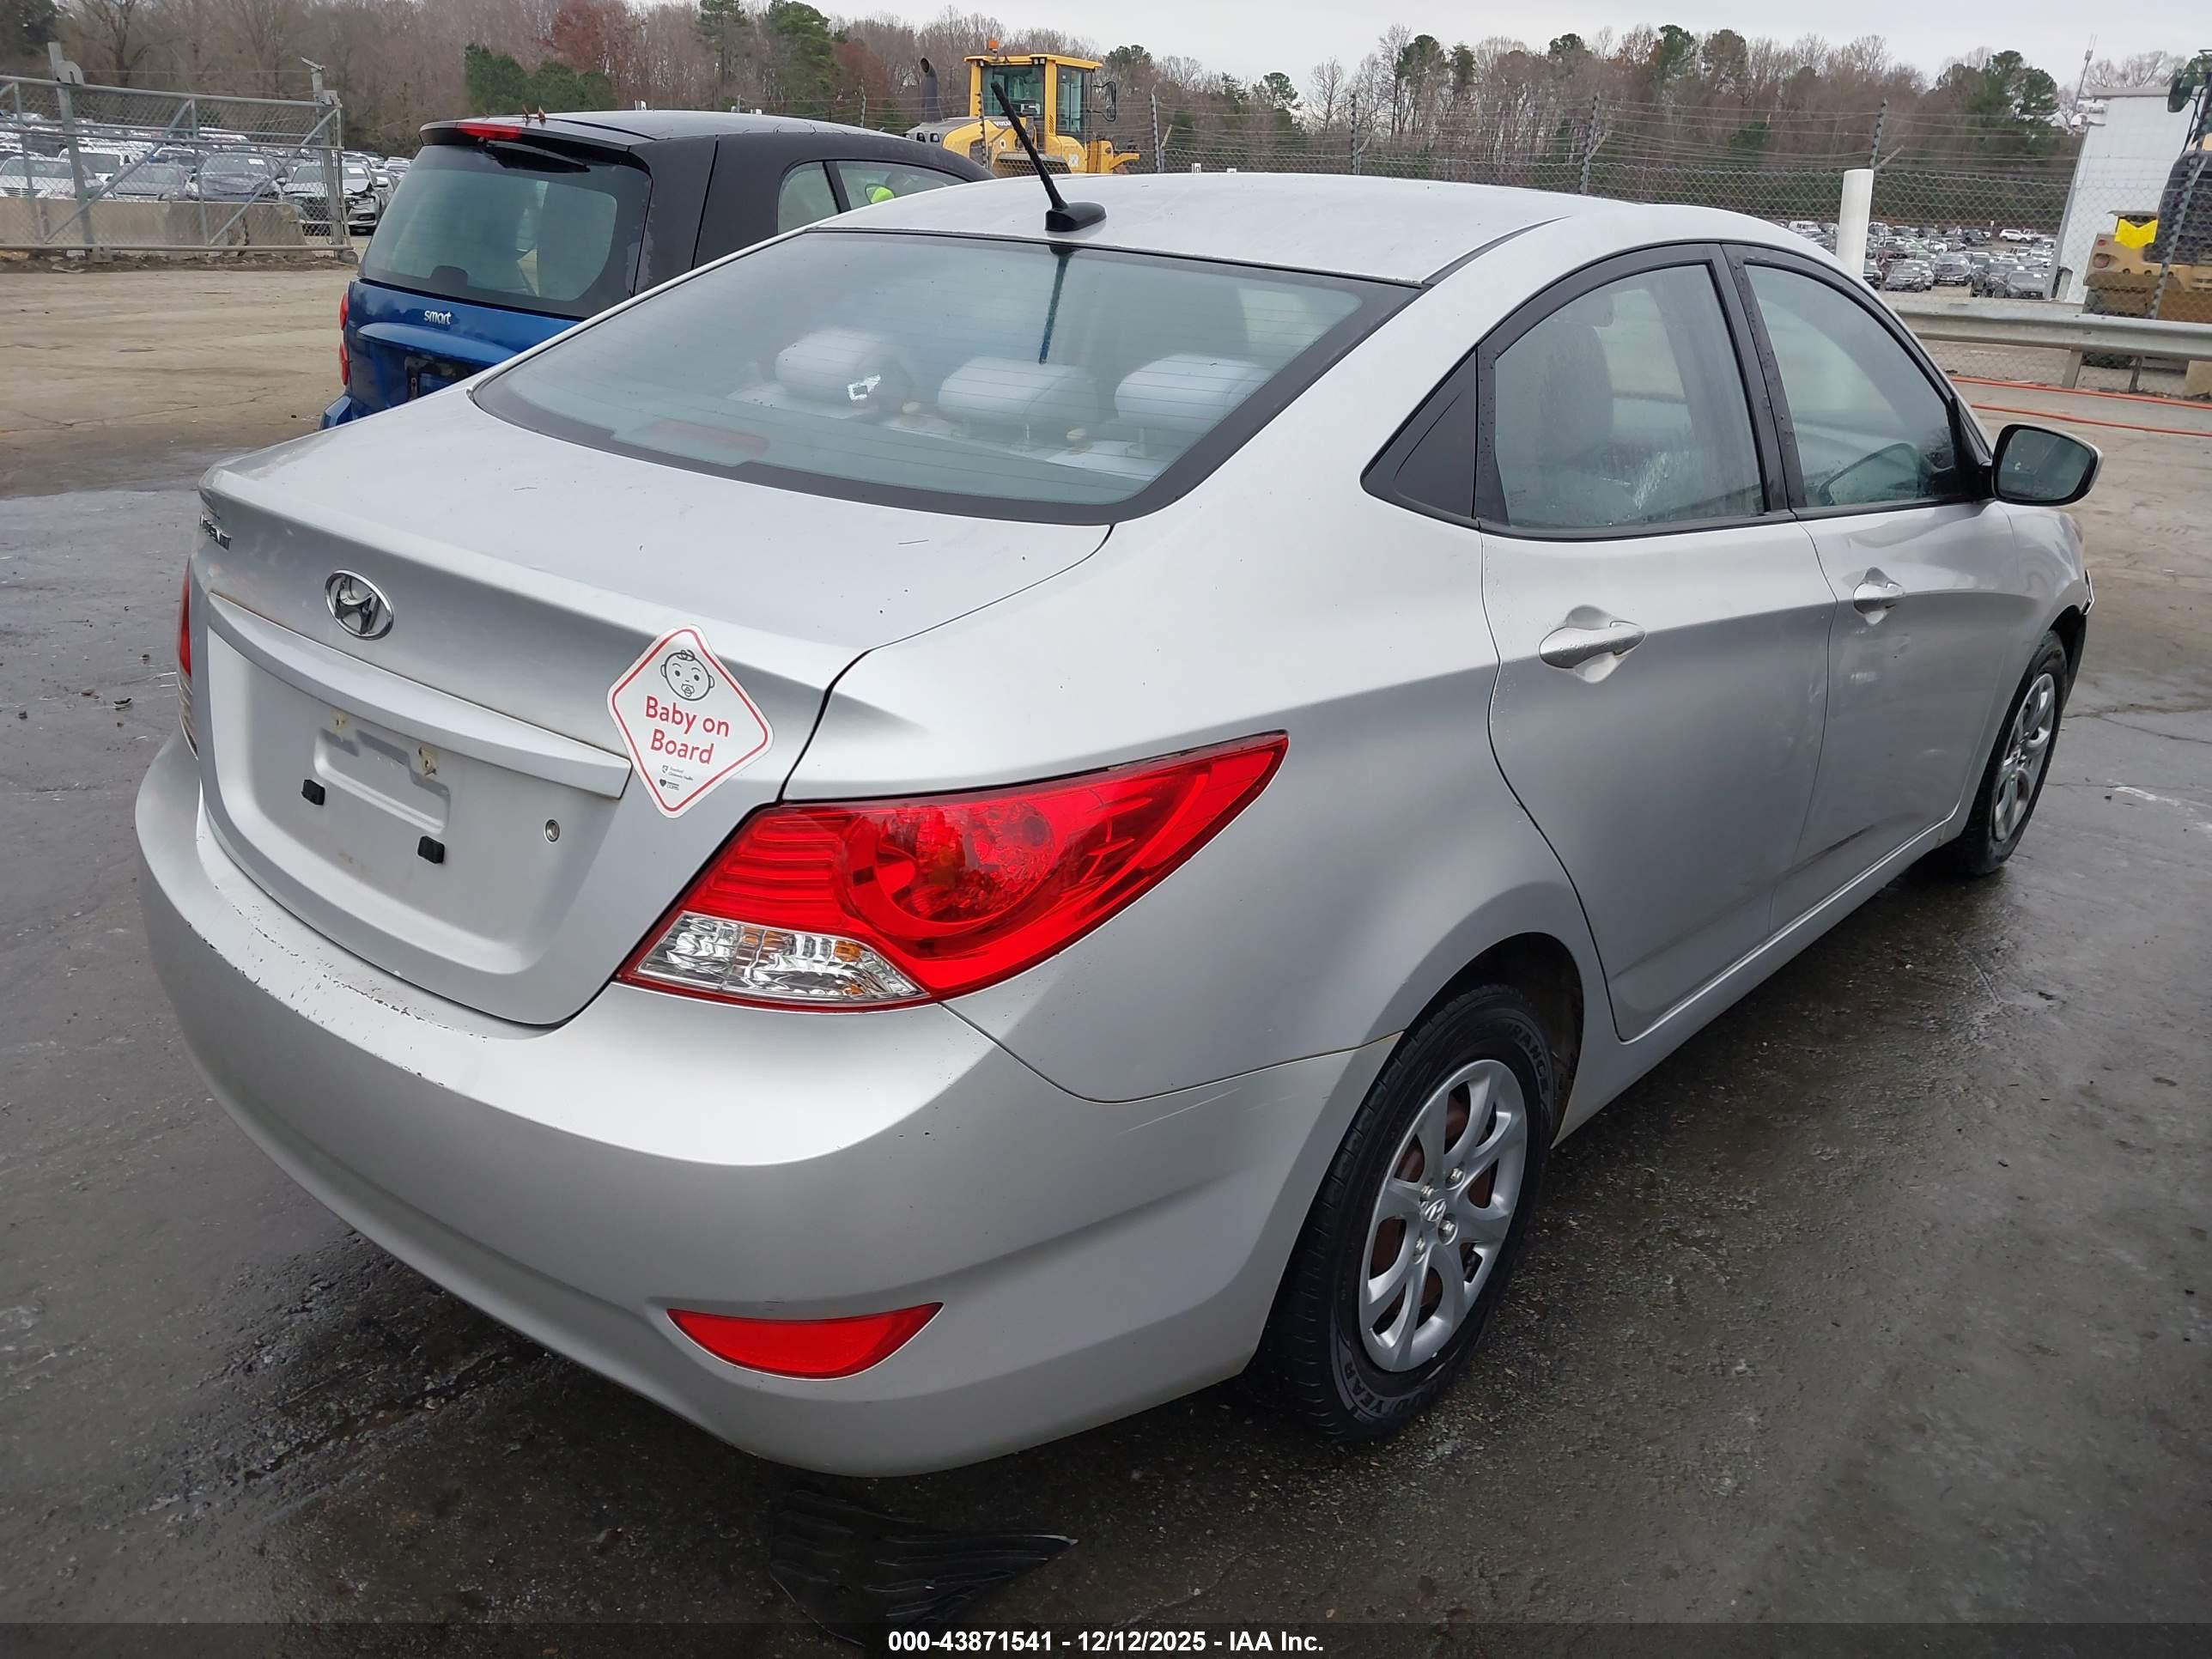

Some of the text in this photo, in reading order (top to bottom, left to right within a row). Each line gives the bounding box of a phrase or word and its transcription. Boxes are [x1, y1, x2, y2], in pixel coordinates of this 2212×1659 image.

[423, 310, 452, 325] smart
[645, 696, 730, 738] Baby on
[650, 728, 714, 764] Board
